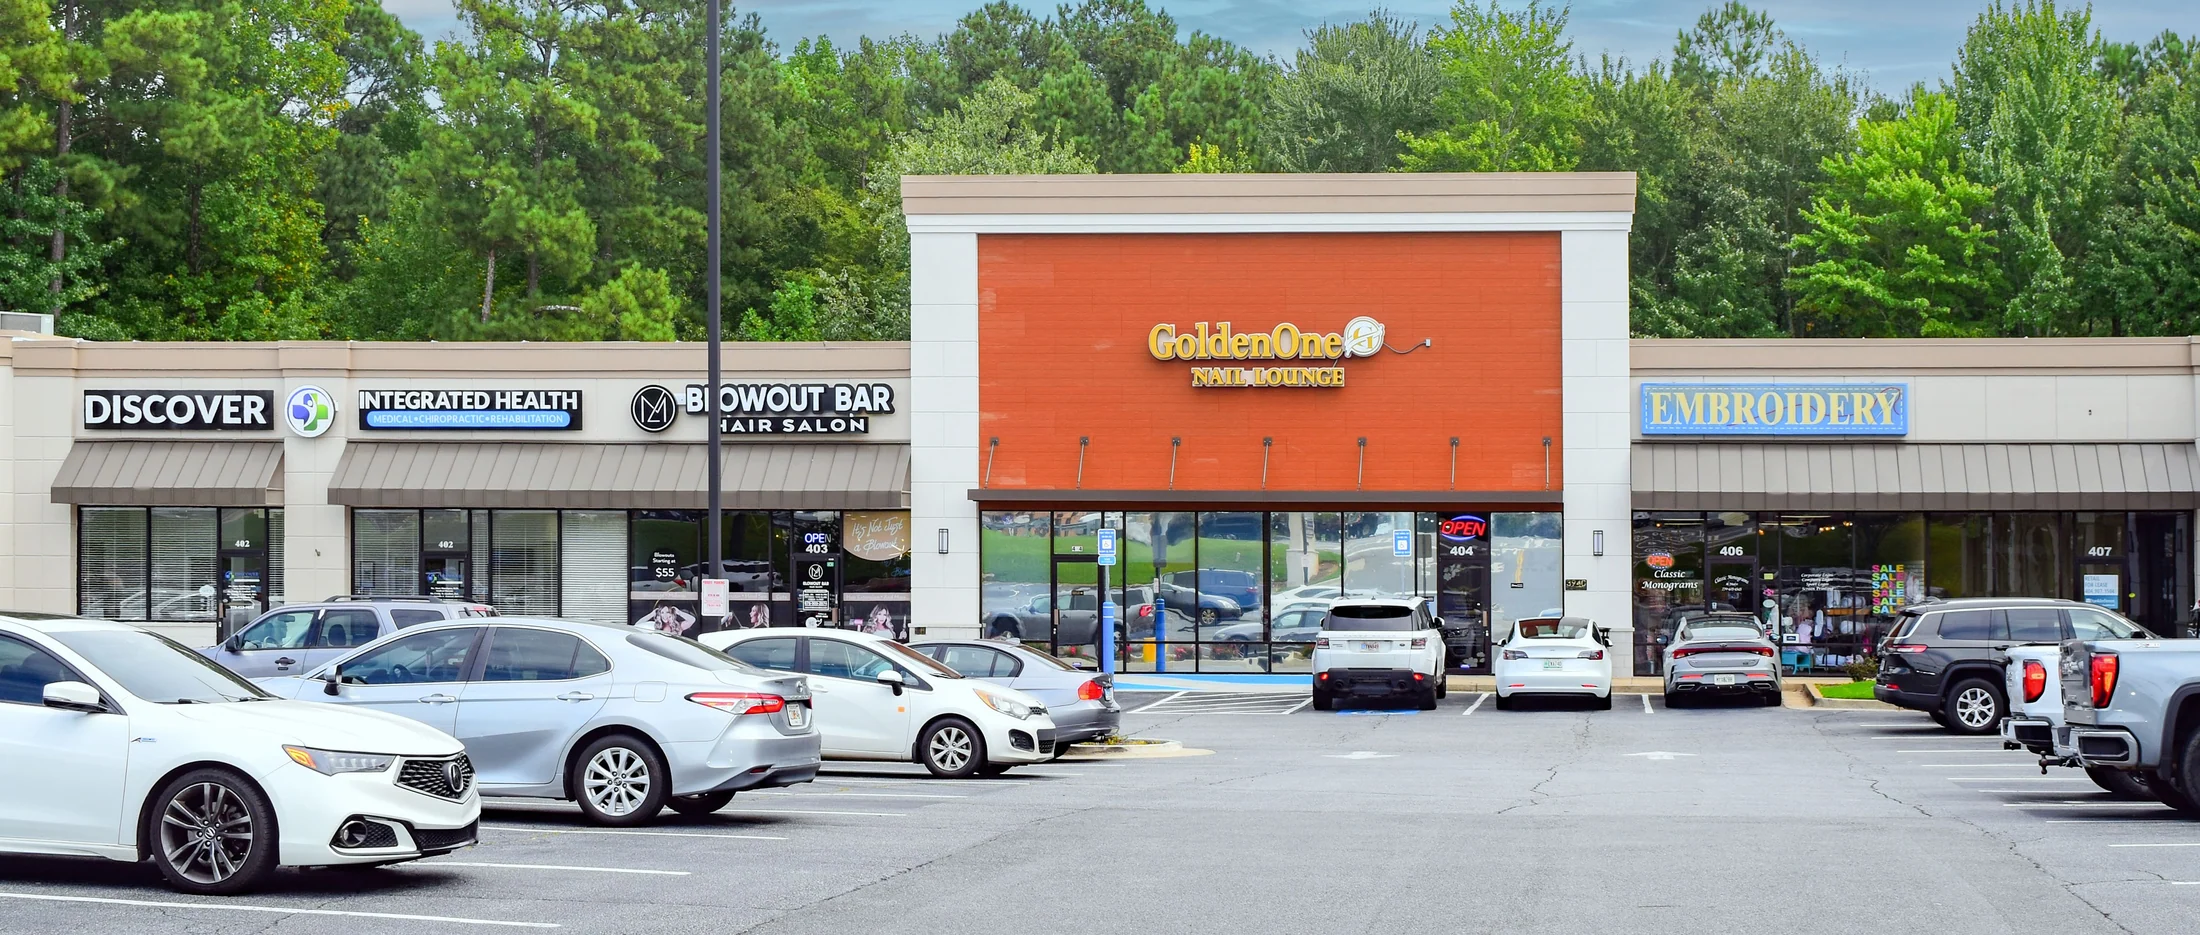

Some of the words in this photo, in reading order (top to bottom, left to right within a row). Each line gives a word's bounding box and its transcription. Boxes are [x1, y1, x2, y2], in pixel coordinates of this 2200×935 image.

[1149, 321, 1343, 359] GoldenOne
[1193, 368, 1246, 386] NAIL
[1255, 368, 1343, 386] LOUNGE
[359, 391, 490, 410] INTEGRATED
[496, 391, 578, 410] HEALTH
[835, 386, 892, 412] BAR
[85, 394, 267, 425] DISCOVER
[1650, 391, 1899, 426] EMBROIDERY
[373, 414, 413, 424] MEDICAL
[419, 414, 485, 424] CHIROPRACTIC
[490, 414, 563, 424] REHABILITATION
[782, 418, 866, 433] SALON
[867, 518, 882, 537] Not
[884, 516, 903, 535] Just
[1441, 520, 1487, 537] OPEN
[234, 539, 251, 548] 402
[804, 532, 832, 544] OPEN
[438, 540, 454, 549] 402
[805, 543, 829, 554] 403
[853, 543, 861, 552] a
[1450, 545, 1474, 556] 404
[1720, 546, 1744, 556] 406
[2088, 546, 2112, 557] 407
[1647, 555, 1674, 567] OPEN
[655, 567, 675, 578] $55
[1872, 564, 1904, 572] SALE
[1654, 569, 1686, 579] Classic
[1641, 580, 1698, 591] Monograms
[1872, 581, 1904, 589] SALE
[1872, 589, 1904, 597] SALE
[1872, 597, 1904, 605] SALE
